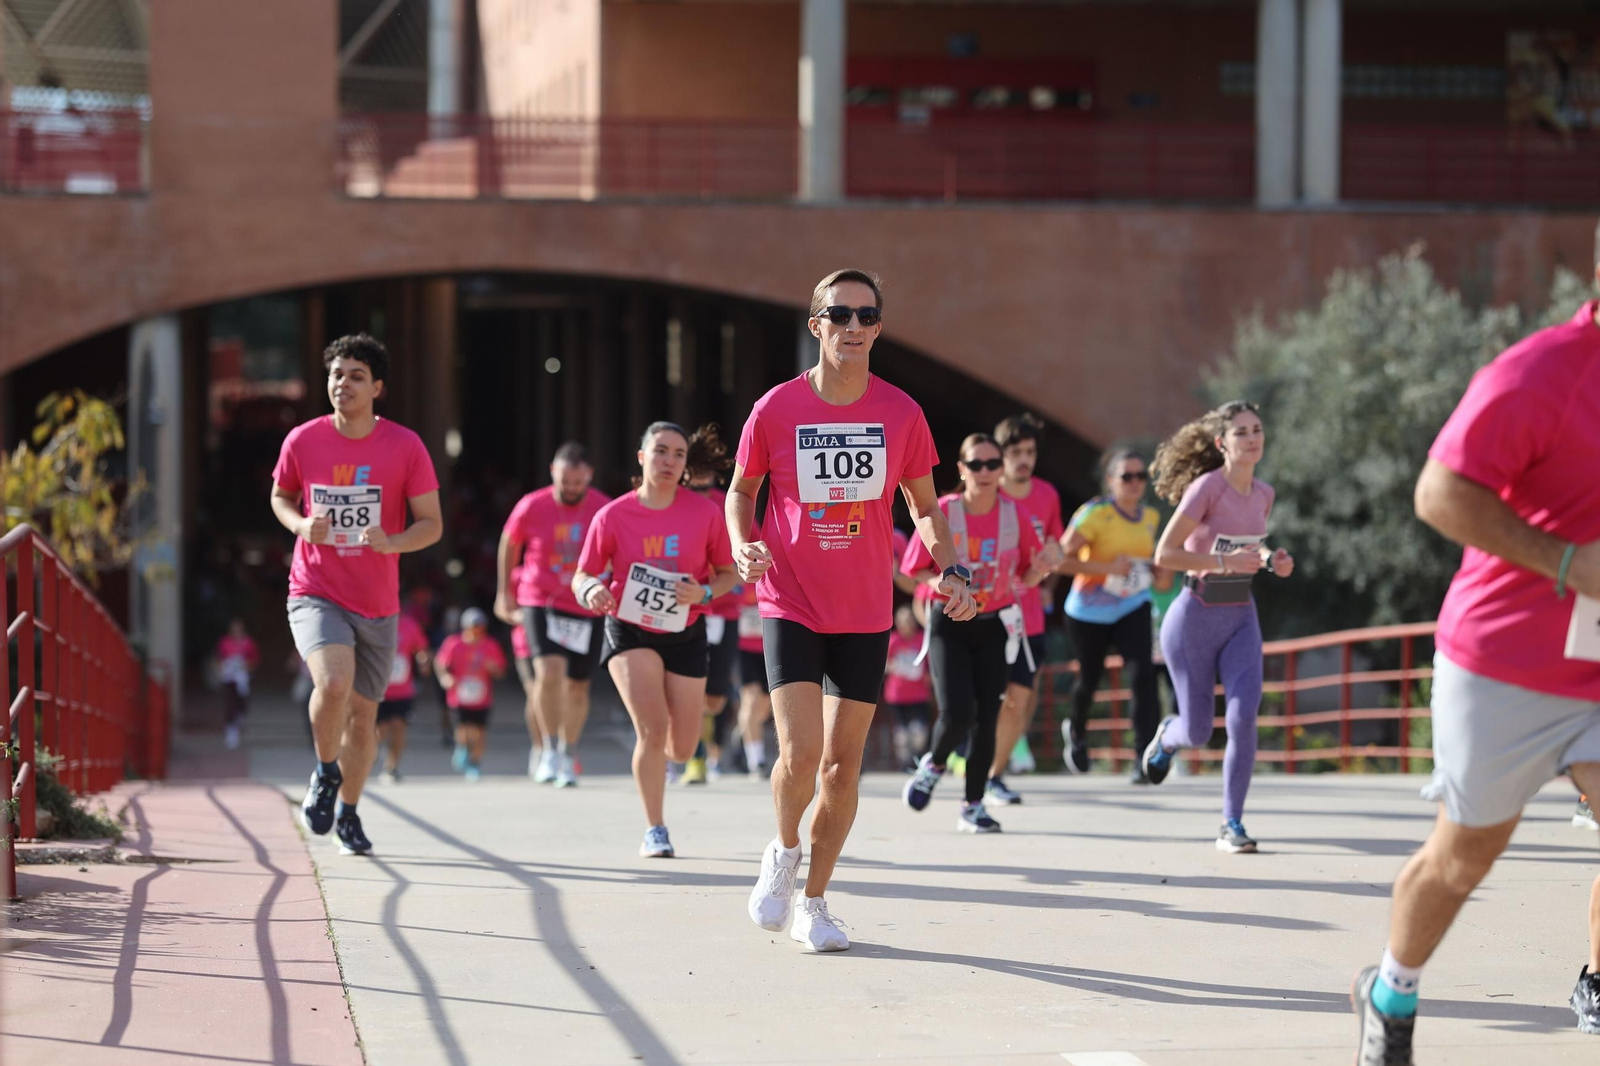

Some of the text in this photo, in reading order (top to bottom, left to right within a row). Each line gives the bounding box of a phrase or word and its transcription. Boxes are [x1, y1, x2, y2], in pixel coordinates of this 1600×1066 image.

[801, 436, 840, 447] UMA
[333, 464, 371, 486] WE
[814, 451, 874, 480] 108
[315, 494, 345, 505] UMA
[326, 506, 370, 529] 468
[642, 534, 679, 558] WE
[632, 571, 662, 588] UMA
[635, 587, 678, 615] 452
